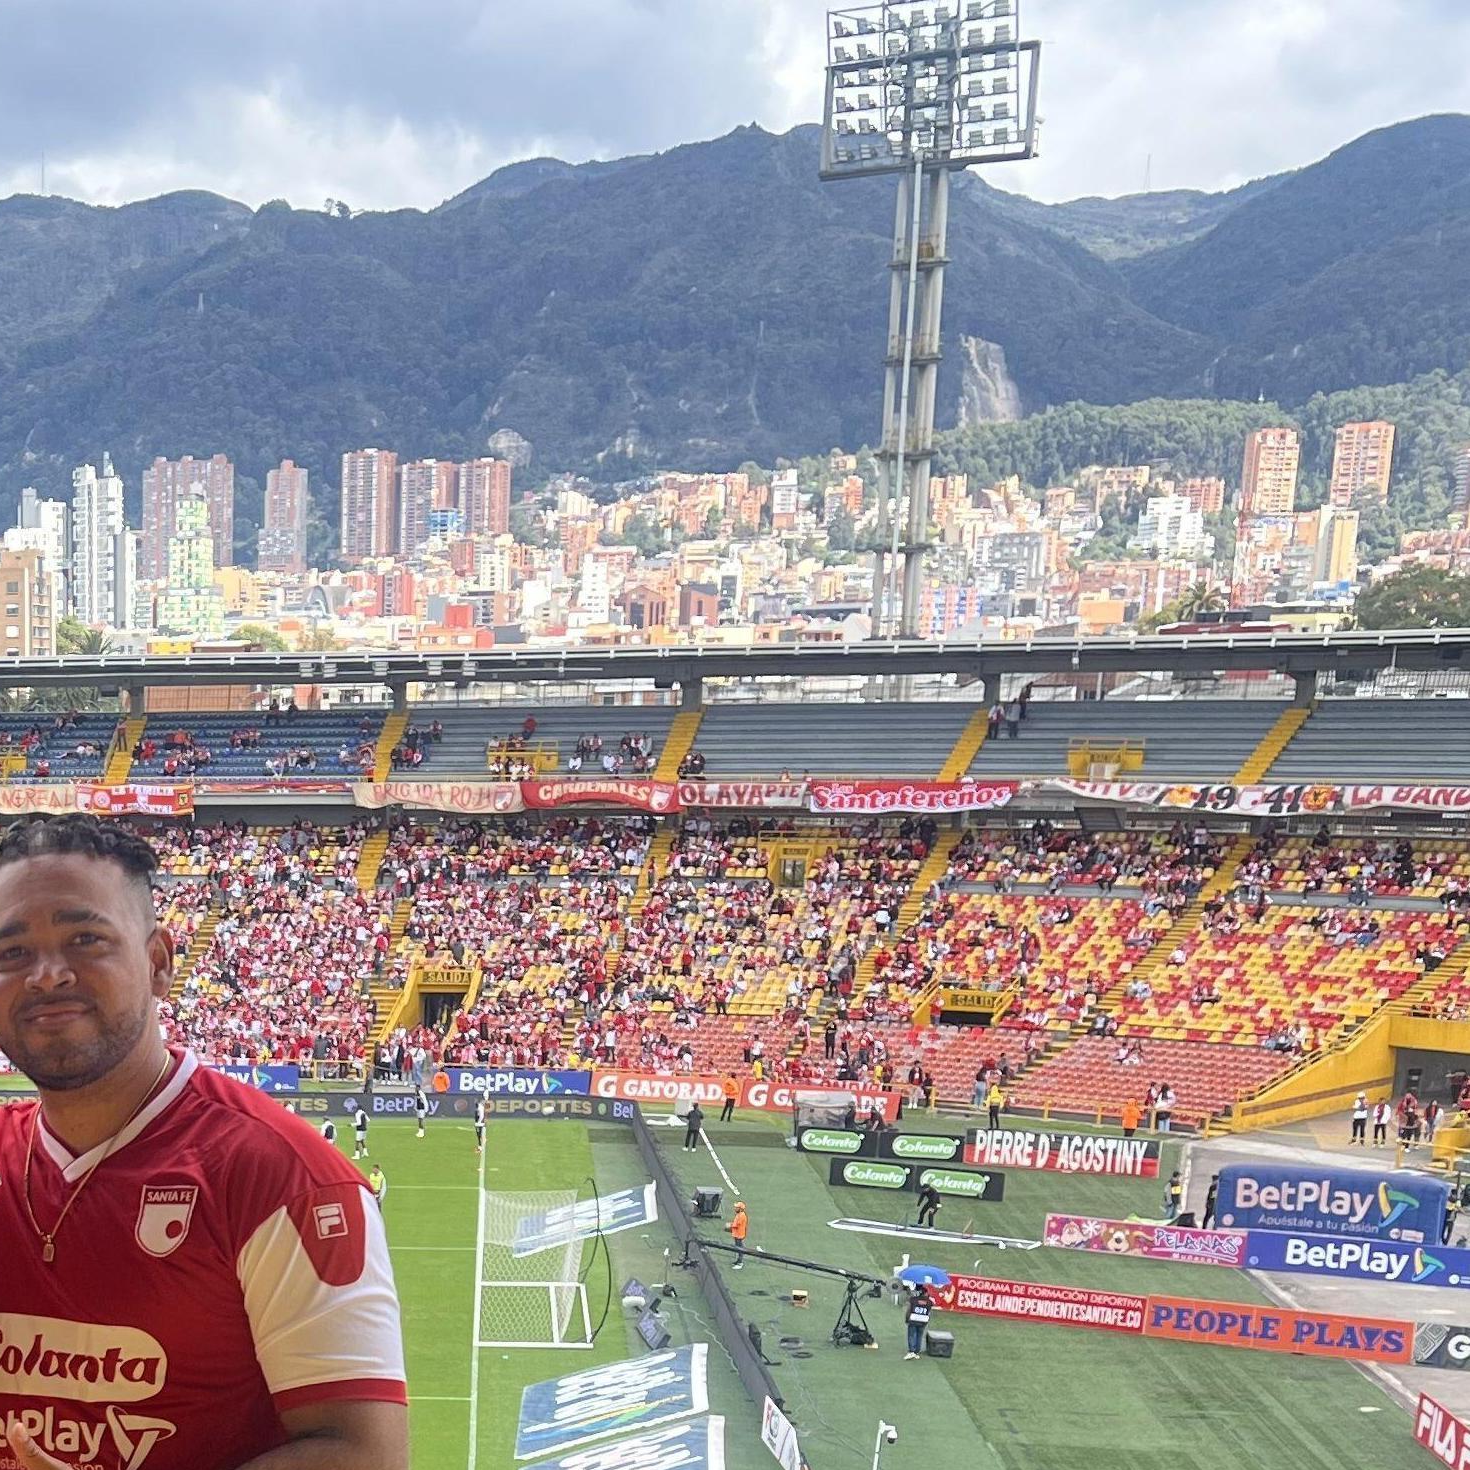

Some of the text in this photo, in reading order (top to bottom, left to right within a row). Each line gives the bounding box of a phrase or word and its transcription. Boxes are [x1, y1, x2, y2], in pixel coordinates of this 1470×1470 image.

[538, 781, 650, 802] CARDENALES
[679, 784, 764, 805] OLAYA
[813, 783, 1012, 810] Santafereños
[1192, 785, 1302, 813] 19 41
[1350, 785, 1385, 805] LA
[426, 971, 470, 983] SALIDA
[459, 1072, 540, 1095] BetPlay
[597, 1075, 728, 1102] G GATORAD
[803, 1131, 859, 1149] Colanta
[894, 1138, 955, 1155] Colanta
[973, 1129, 1036, 1169] PIERRE
[1057, 1135, 1150, 1176] AGOSTINY
[845, 1164, 905, 1184] Colanta
[146, 1190, 193, 1203] SANTA FE
[1235, 1177, 1375, 1224] BetPlay
[1153, 1227, 1239, 1257] PELANAS
[1285, 1238, 1410, 1280] BetPlay
[957, 1278, 1011, 1292] PROGRAMA
[1012, 1284, 1026, 1295] DE
[1089, 1292, 1143, 1309] DEPORTIVA
[1150, 1304, 1406, 1354] PEOPLE PLAYS
[1417, 1397, 1457, 1466] FILA
